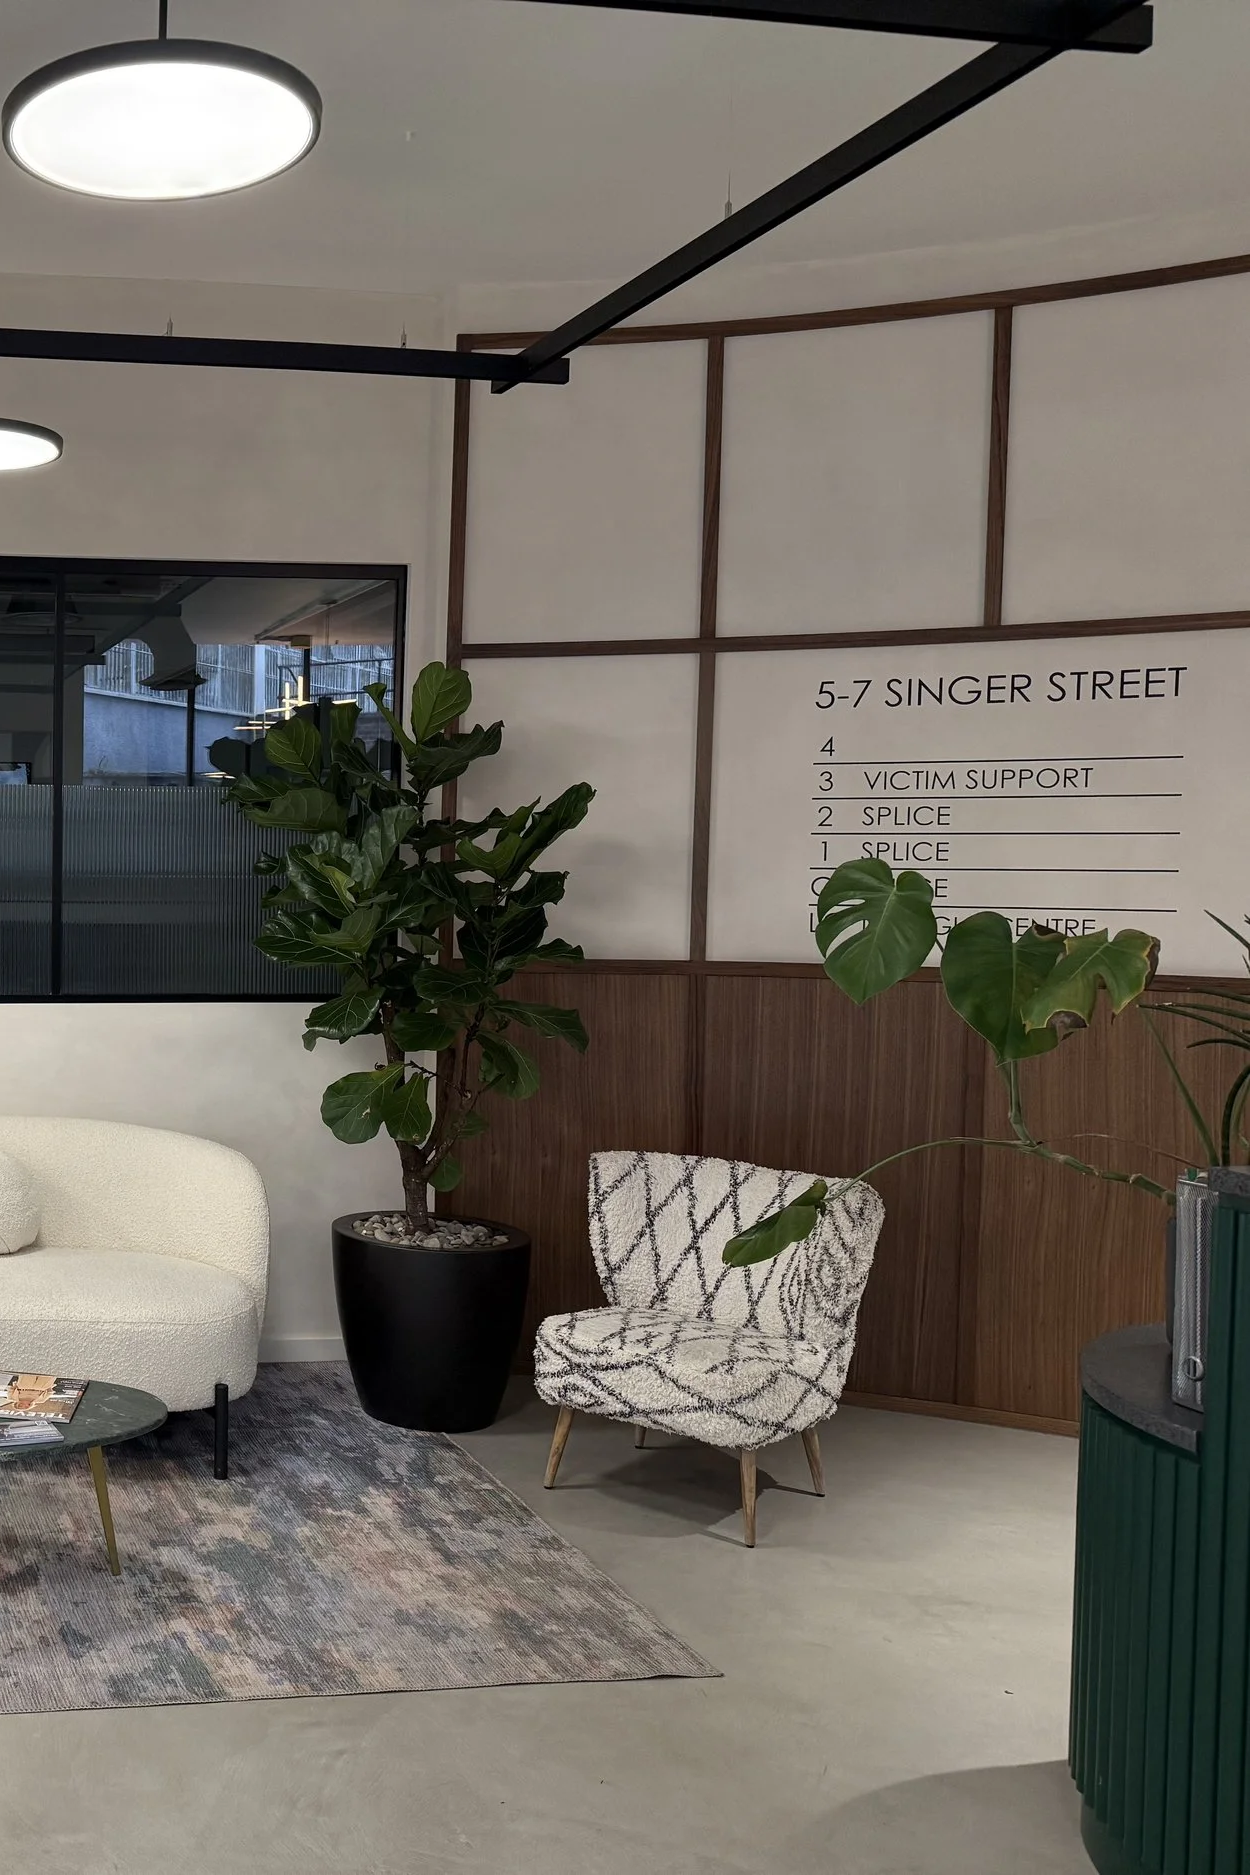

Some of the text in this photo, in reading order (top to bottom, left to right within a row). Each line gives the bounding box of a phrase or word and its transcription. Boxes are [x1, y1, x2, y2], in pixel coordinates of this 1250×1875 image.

[815, 667, 1188, 710] 5-7 SINGER STREET
[819, 736, 836, 757] 4
[818, 767, 1094, 792] 3 VICTIM SUPPORT
[817, 806, 951, 827] 2 SPLICE
[821, 841, 950, 862] 1 SPLICE
